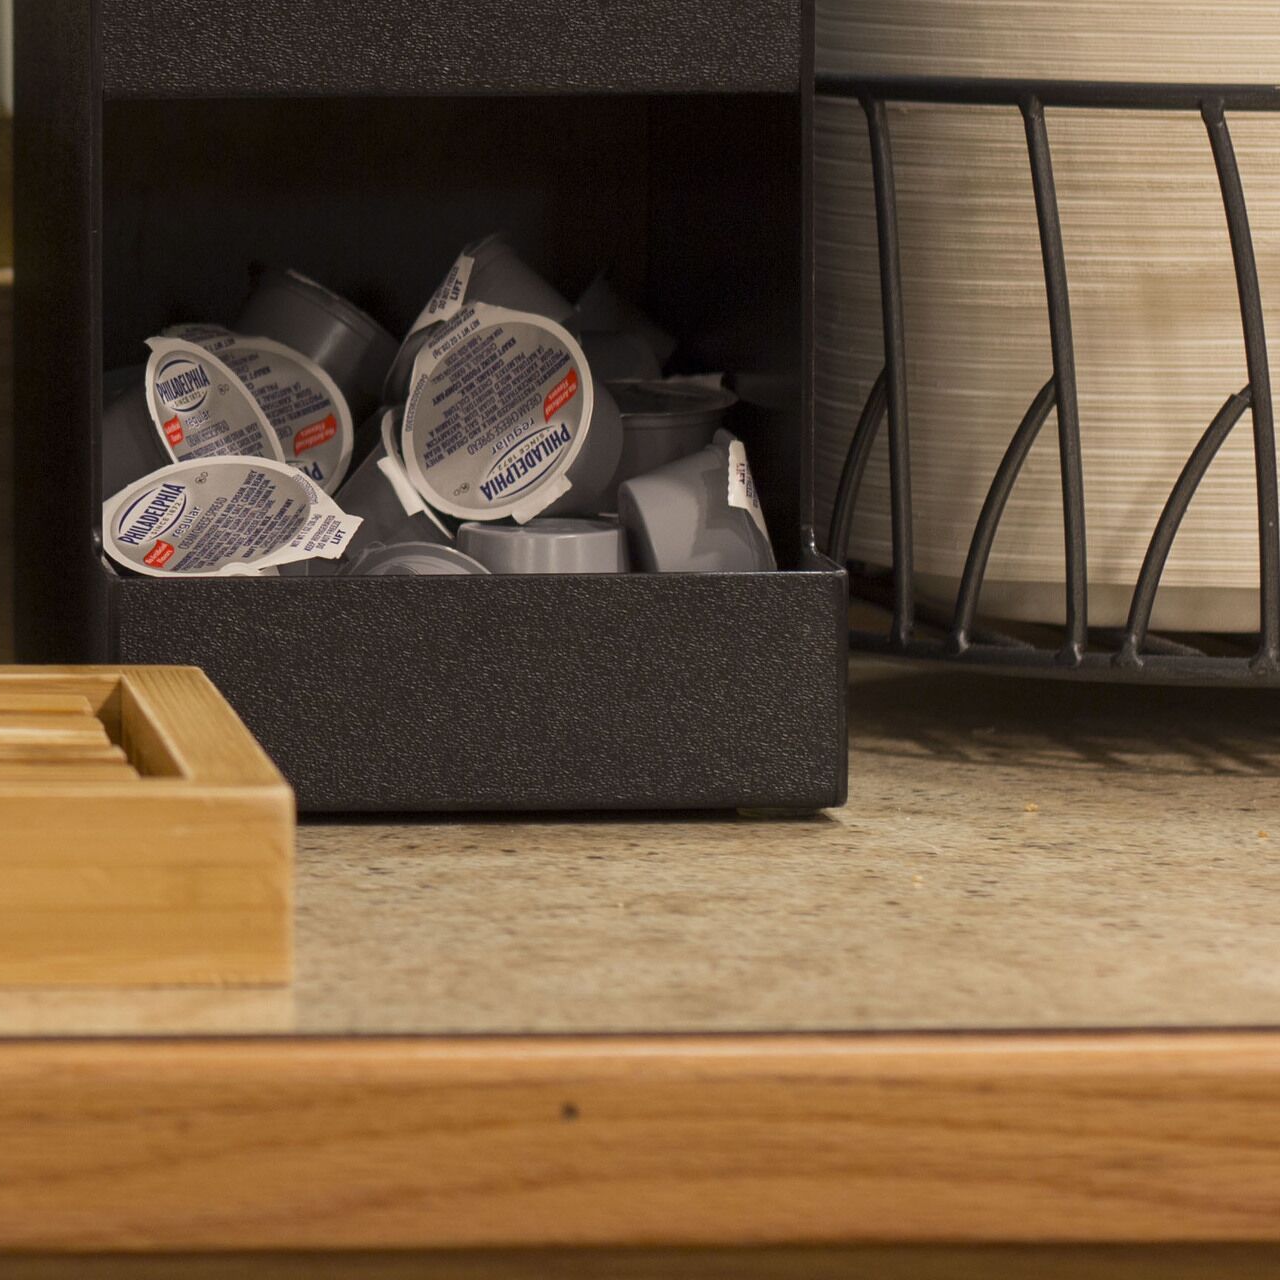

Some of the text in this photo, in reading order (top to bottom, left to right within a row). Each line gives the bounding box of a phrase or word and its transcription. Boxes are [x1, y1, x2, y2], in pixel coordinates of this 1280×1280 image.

[447, 278, 465, 301] LIFT
[153, 362, 212, 404] PHILADELPHIA
[182, 408, 214, 429] regular
[465, 392, 544, 456] CREAM CHEESE SPREAD
[487, 416, 537, 456] regular
[476, 422, 574, 502] PHILADELPHIA
[495, 431, 545, 471] SINCE 1872
[112, 483, 189, 544] PHILADELPHIA
[149, 517, 170, 534] SINCE
[165, 505, 206, 537] regular
[330, 529, 345, 543] LIFT
